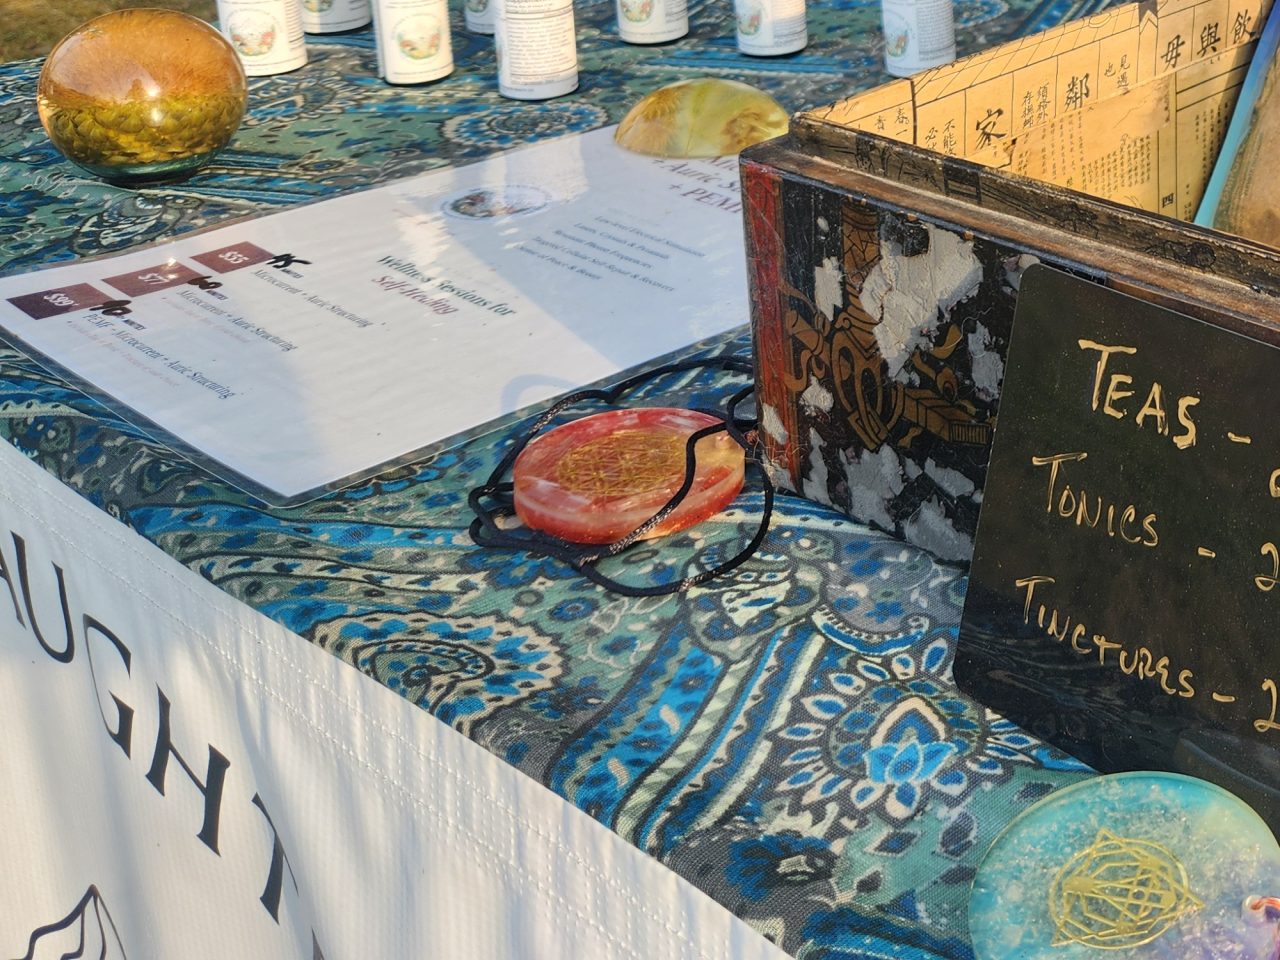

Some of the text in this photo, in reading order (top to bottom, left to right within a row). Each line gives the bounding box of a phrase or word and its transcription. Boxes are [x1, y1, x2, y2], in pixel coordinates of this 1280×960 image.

[658, 162, 723, 184] Auric
[679, 187, 744, 215] PEM
[217, 249, 250, 265] $55
[370, 274, 460, 316] Self-Healing
[376, 254, 518, 317] Wellness Sessions for
[1078, 337, 1202, 449] TEAS
[1032, 451, 1160, 548] TONICS
[1014, 574, 1197, 700] TINCTURES
